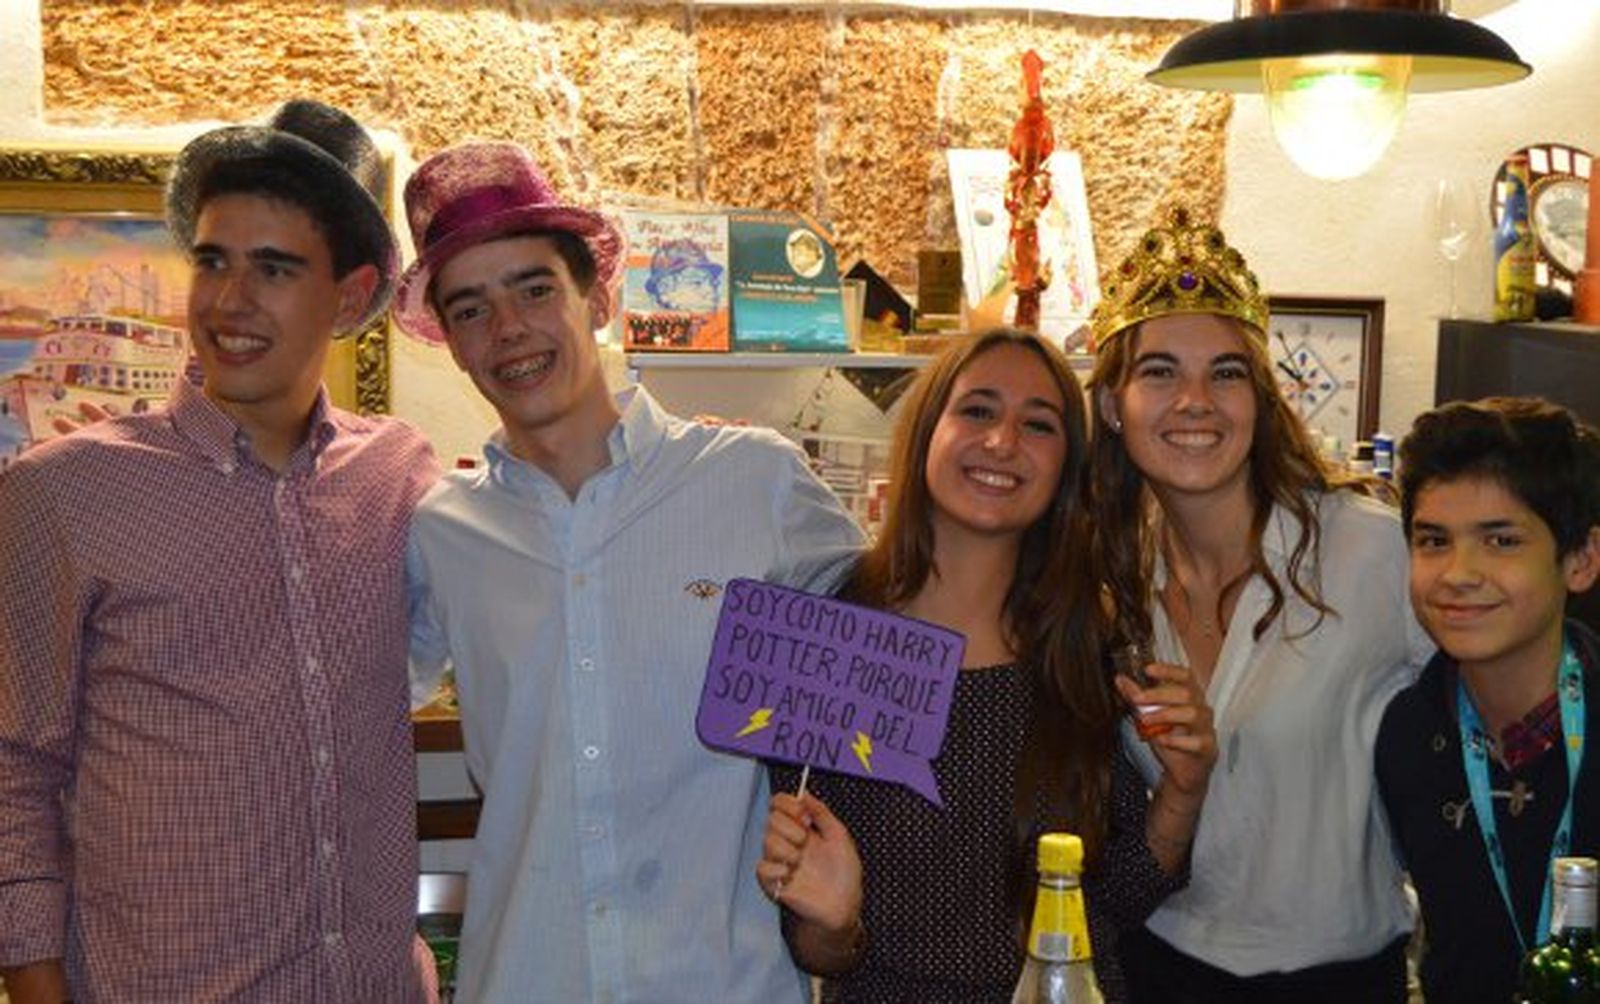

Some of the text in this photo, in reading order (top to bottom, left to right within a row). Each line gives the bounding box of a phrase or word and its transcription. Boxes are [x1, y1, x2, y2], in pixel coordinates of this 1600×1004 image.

[728, 581, 954, 669] SOY COMO HARRY
[714, 664, 920, 756] SOY AMIGO DEL
[846, 655, 942, 715] PORQUE
[772, 721, 843, 768] RON
